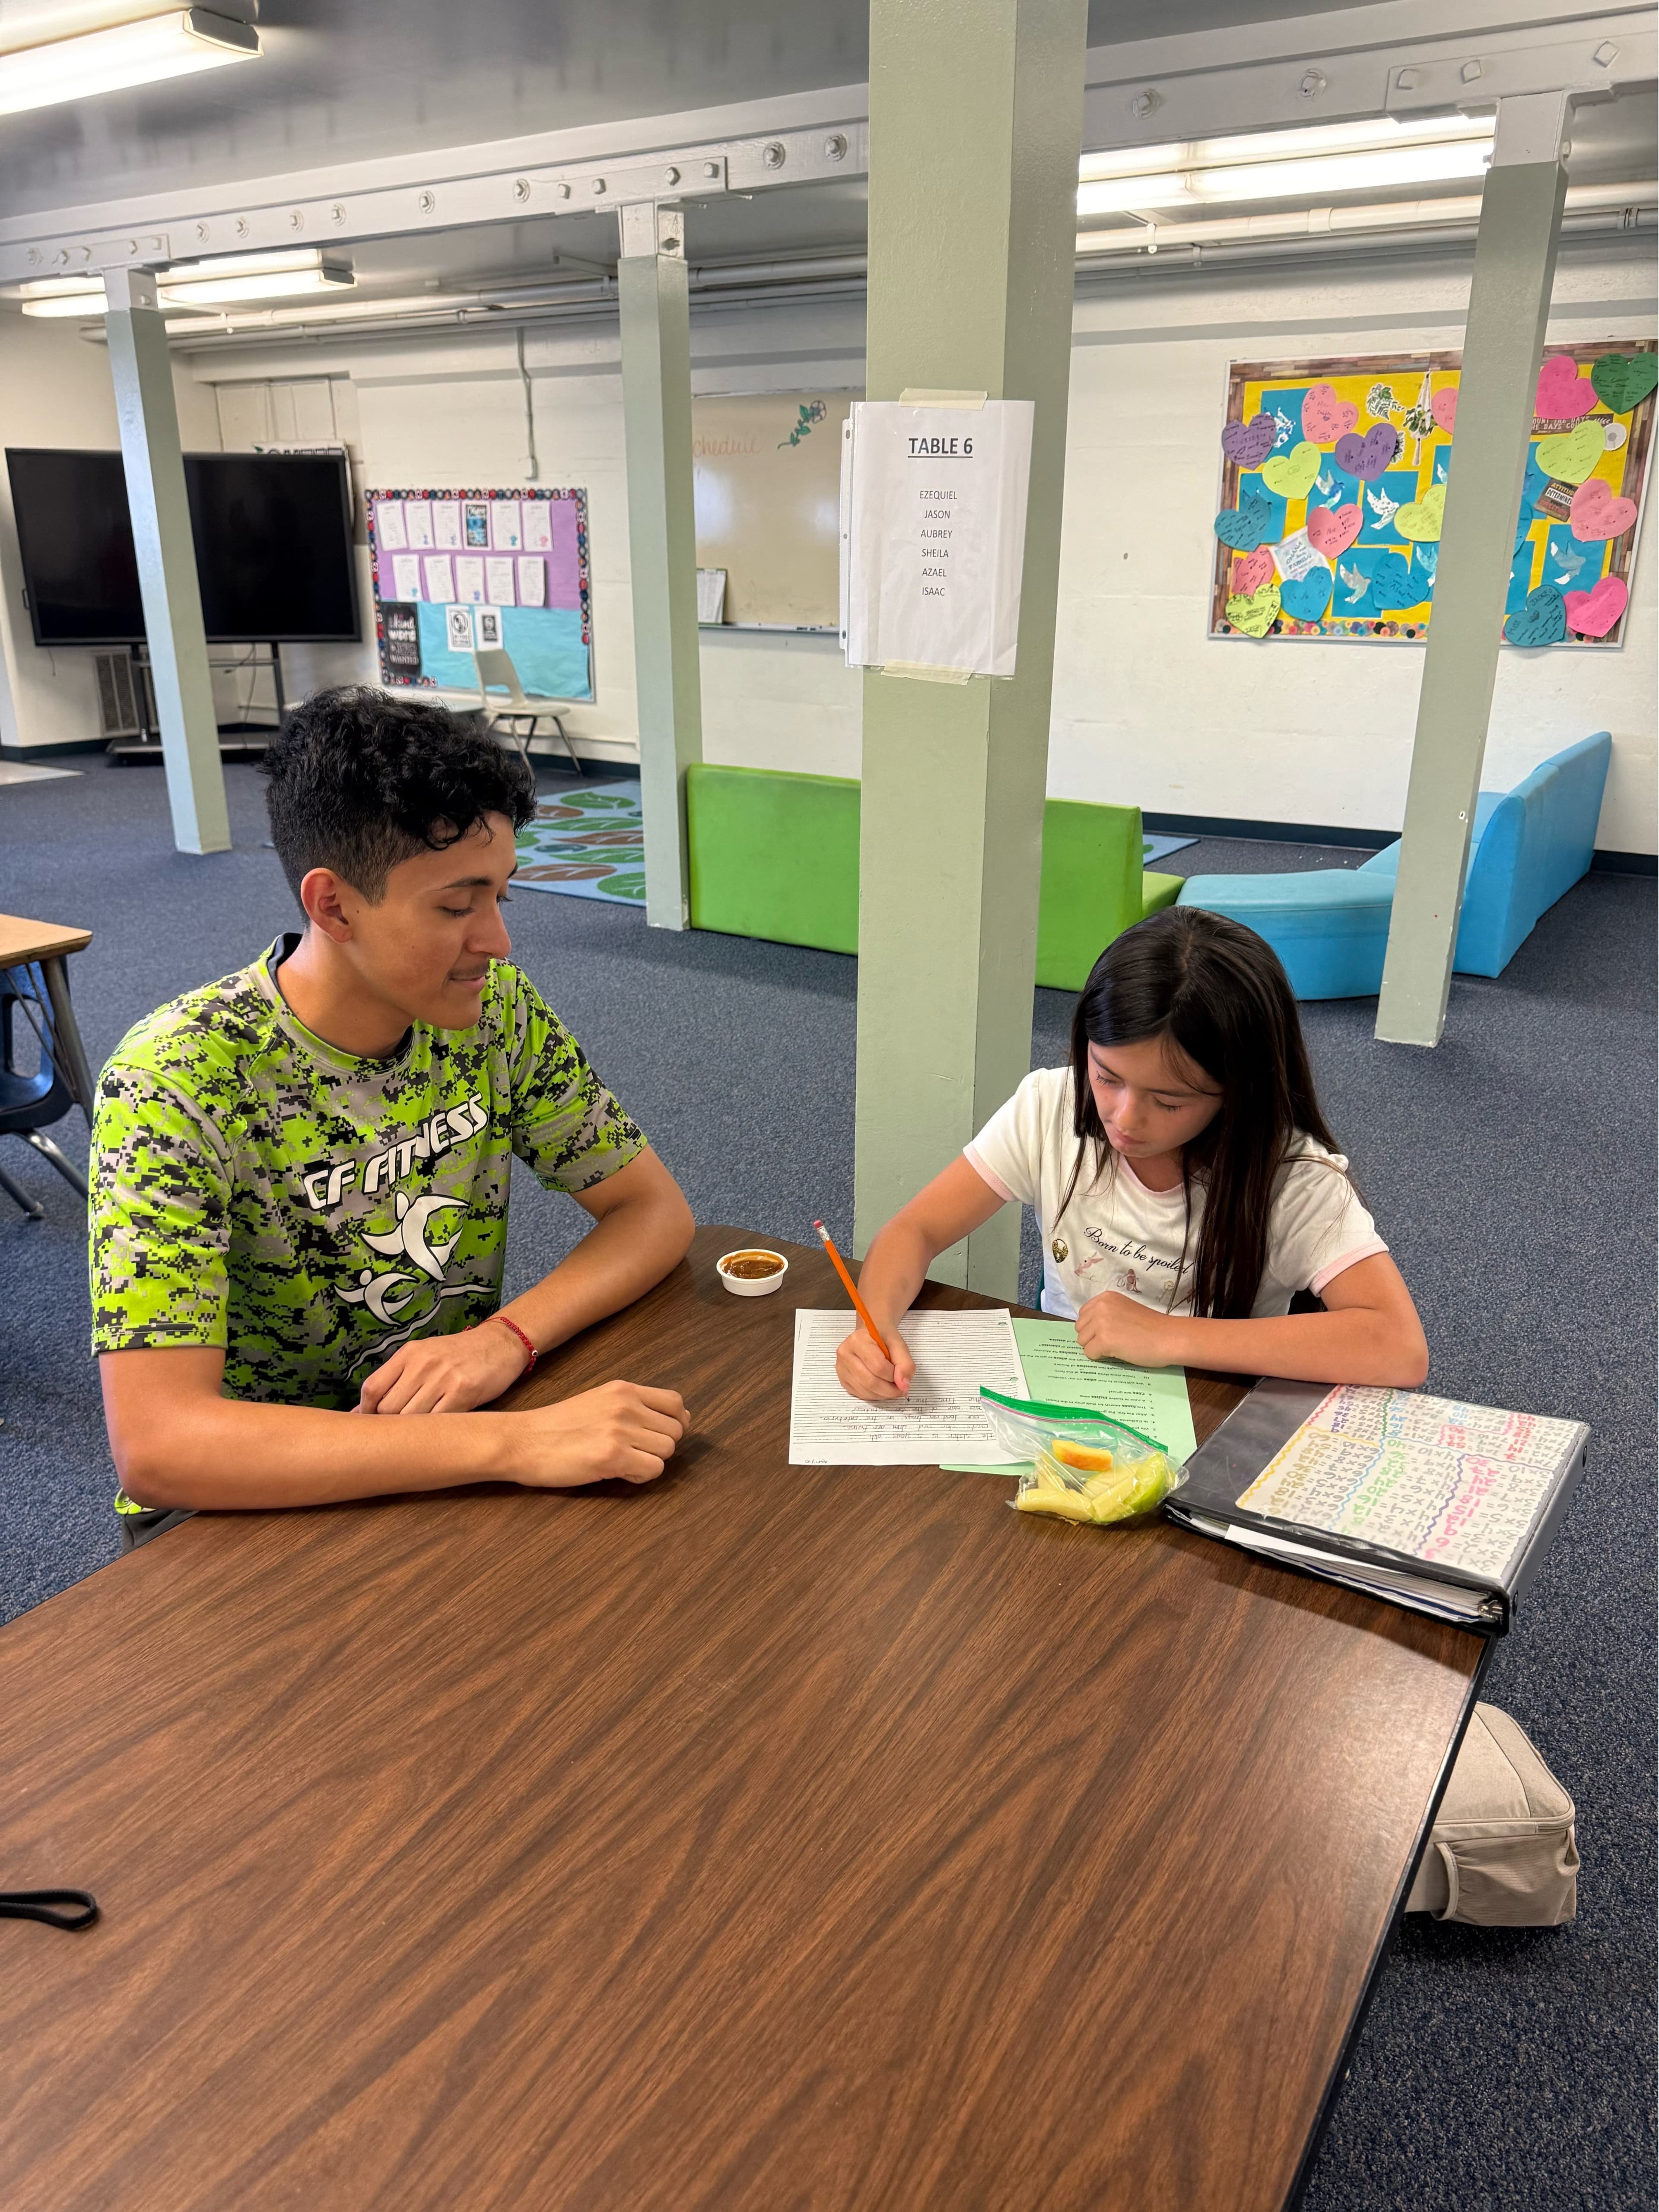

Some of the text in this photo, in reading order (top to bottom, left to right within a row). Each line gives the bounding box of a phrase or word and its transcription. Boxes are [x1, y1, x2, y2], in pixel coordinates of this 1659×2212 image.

[908, 438, 973, 454] TABLE 6
[919, 490, 957, 500] EZEQUIEL
[925, 510, 950, 519] JASON
[921, 529, 953, 540] AUBREY
[922, 548, 949, 558] SHEILA
[922, 568, 947, 577] AZAEL
[922, 587, 945, 596] ISAAC
[362, 1093, 489, 1194] FITNESS
[1084, 1227, 1194, 1274] Born to be spoiled
